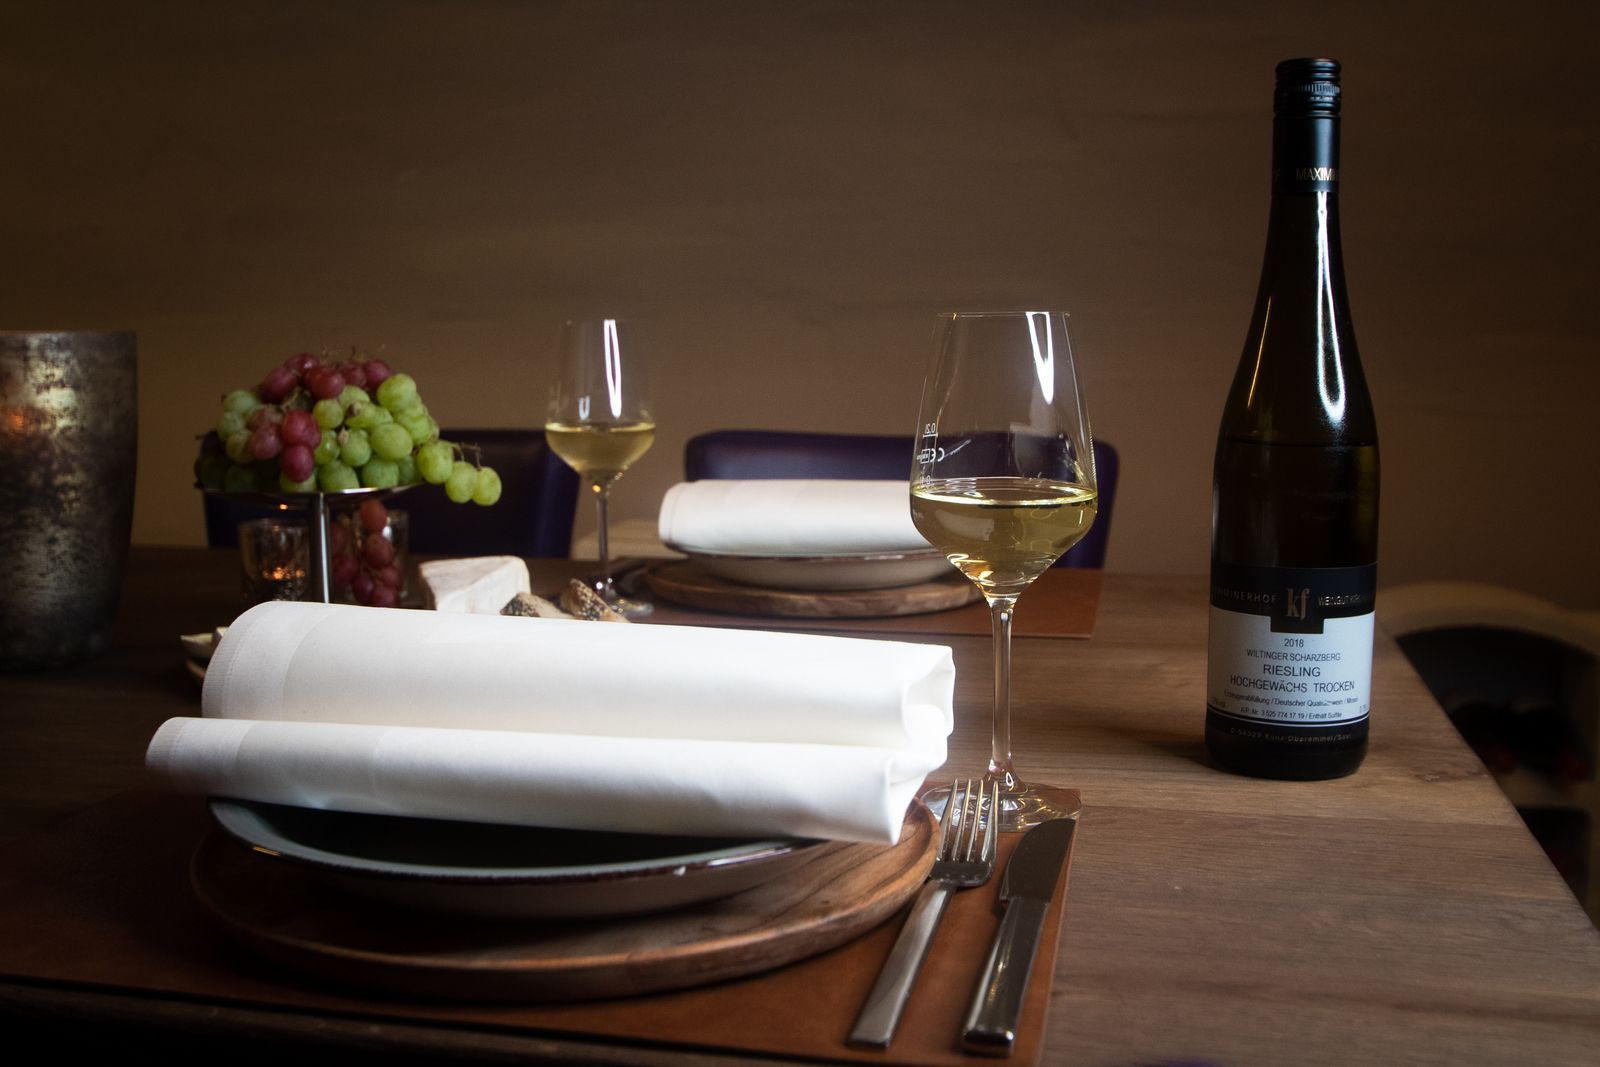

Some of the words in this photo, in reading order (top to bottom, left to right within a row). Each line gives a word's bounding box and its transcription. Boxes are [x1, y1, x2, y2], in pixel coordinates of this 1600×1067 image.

[1284, 638, 1304, 648] 2018
[1246, 649, 1288, 661] WILTINGER
[1289, 652, 1341, 662] SCHARZBERG
[1263, 664, 1321, 678] RIESLING
[1230, 675, 1308, 693] HOCHGEWÄCHS
[1314, 681, 1355, 693] TROCKEN
[1274, 698, 1306, 706] Deutscher
